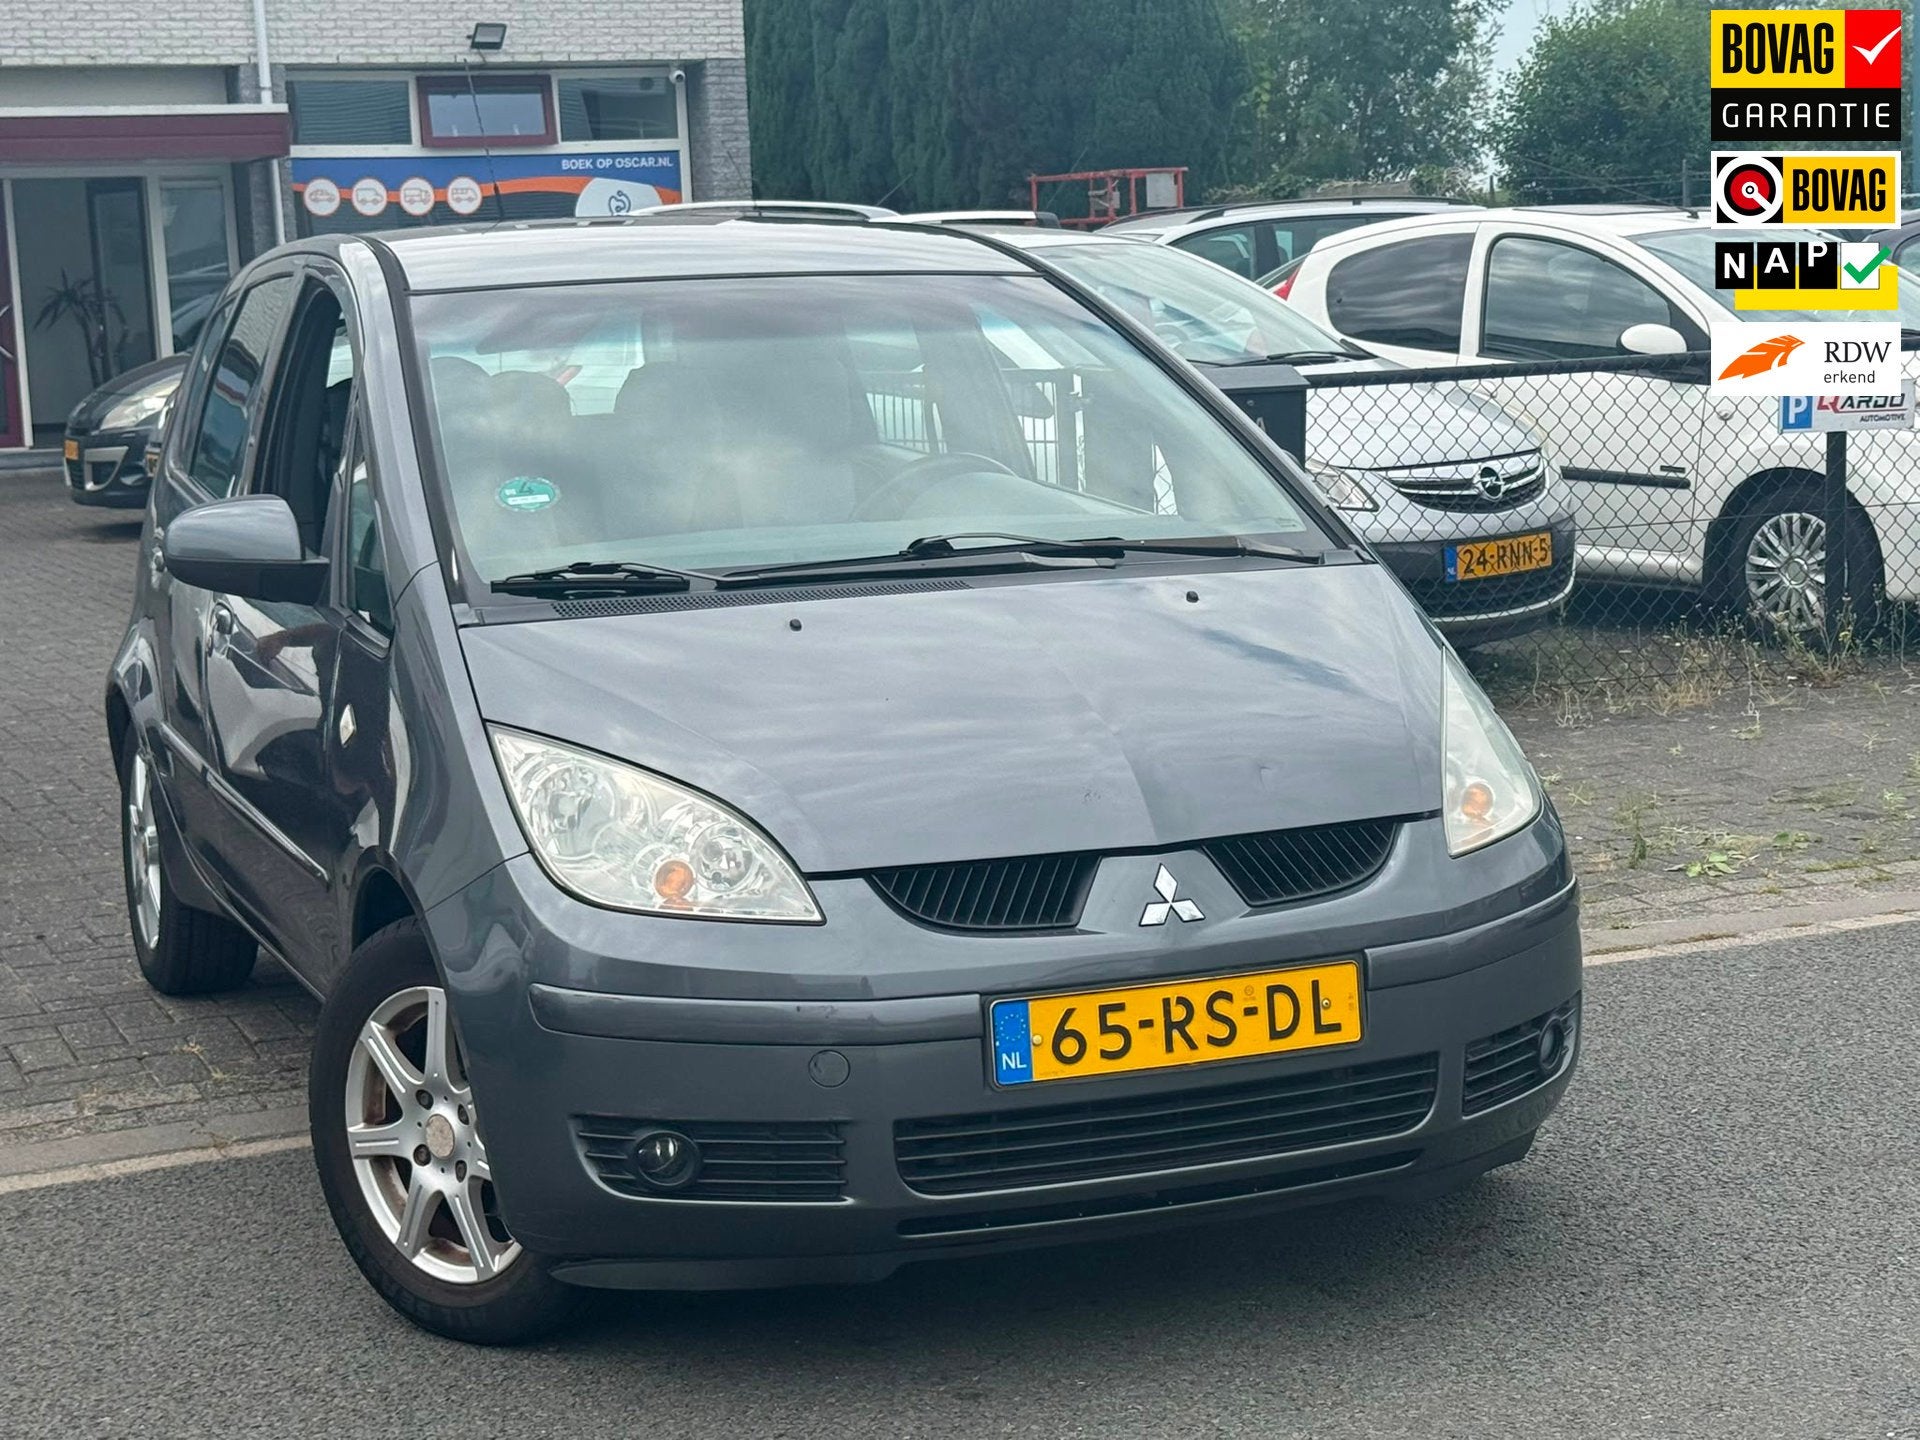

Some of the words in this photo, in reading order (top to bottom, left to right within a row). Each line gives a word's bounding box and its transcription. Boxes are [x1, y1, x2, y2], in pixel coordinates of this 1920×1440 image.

[561, 159, 593, 170] BOEK
[596, 158, 613, 169] OP
[615, 156, 674, 169] OSCAR.NL
[1788, 396, 1808, 425] P
[1860, 413, 1906, 423] AUTOMOTIVE
[1463, 538, 1548, 574] 24-RNN-5
[1001, 1052, 1027, 1071] NL
[1051, 979, 1342, 1066] 65-RS-DL
